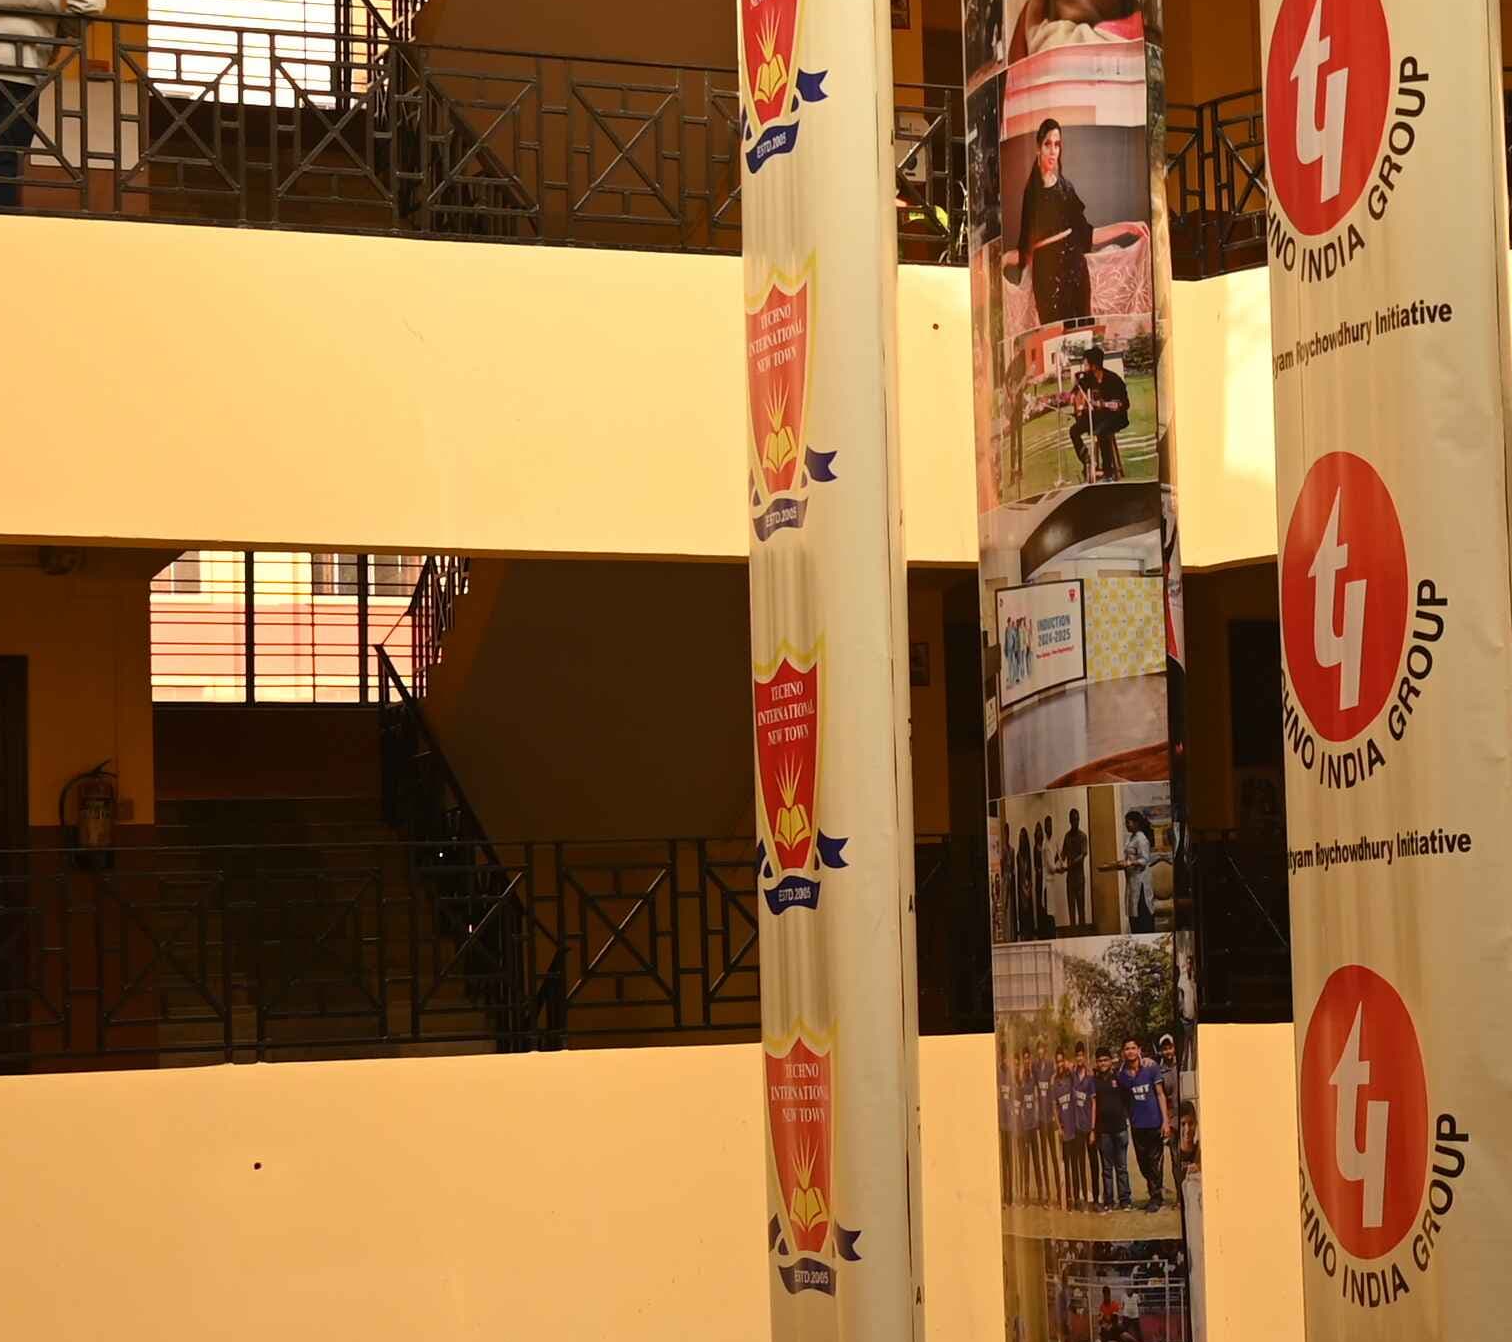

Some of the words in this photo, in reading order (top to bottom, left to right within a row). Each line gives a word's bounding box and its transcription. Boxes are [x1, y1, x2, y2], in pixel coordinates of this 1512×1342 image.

[1301, 223, 1366, 283] INDIA
[1368, 55, 1429, 221] GROUP
[760, 303, 792, 332] TECHNO
[1375, 299, 1453, 336] Initiative
[749, 319, 804, 359] INTERNATIONAL
[756, 353, 772, 374] NEW
[773, 345, 798, 369] TOWN
[771, 680, 804, 702] TECHNO
[1319, 738, 1387, 789] INDIA
[1388, 578, 1448, 742] GROUP
[757, 698, 815, 727] INTERNATIONAL
[767, 728, 783, 747] NEW
[783, 722, 809, 743] TOWN
[1397, 828, 1472, 858] Initiative
[784, 1062, 819, 1080] TECHNO
[782, 1107, 798, 1124] NEW
[799, 1107, 825, 1124] TOWN
[1342, 1263, 1410, 1309] INDIA
[1412, 1113, 1470, 1273] GROUP
